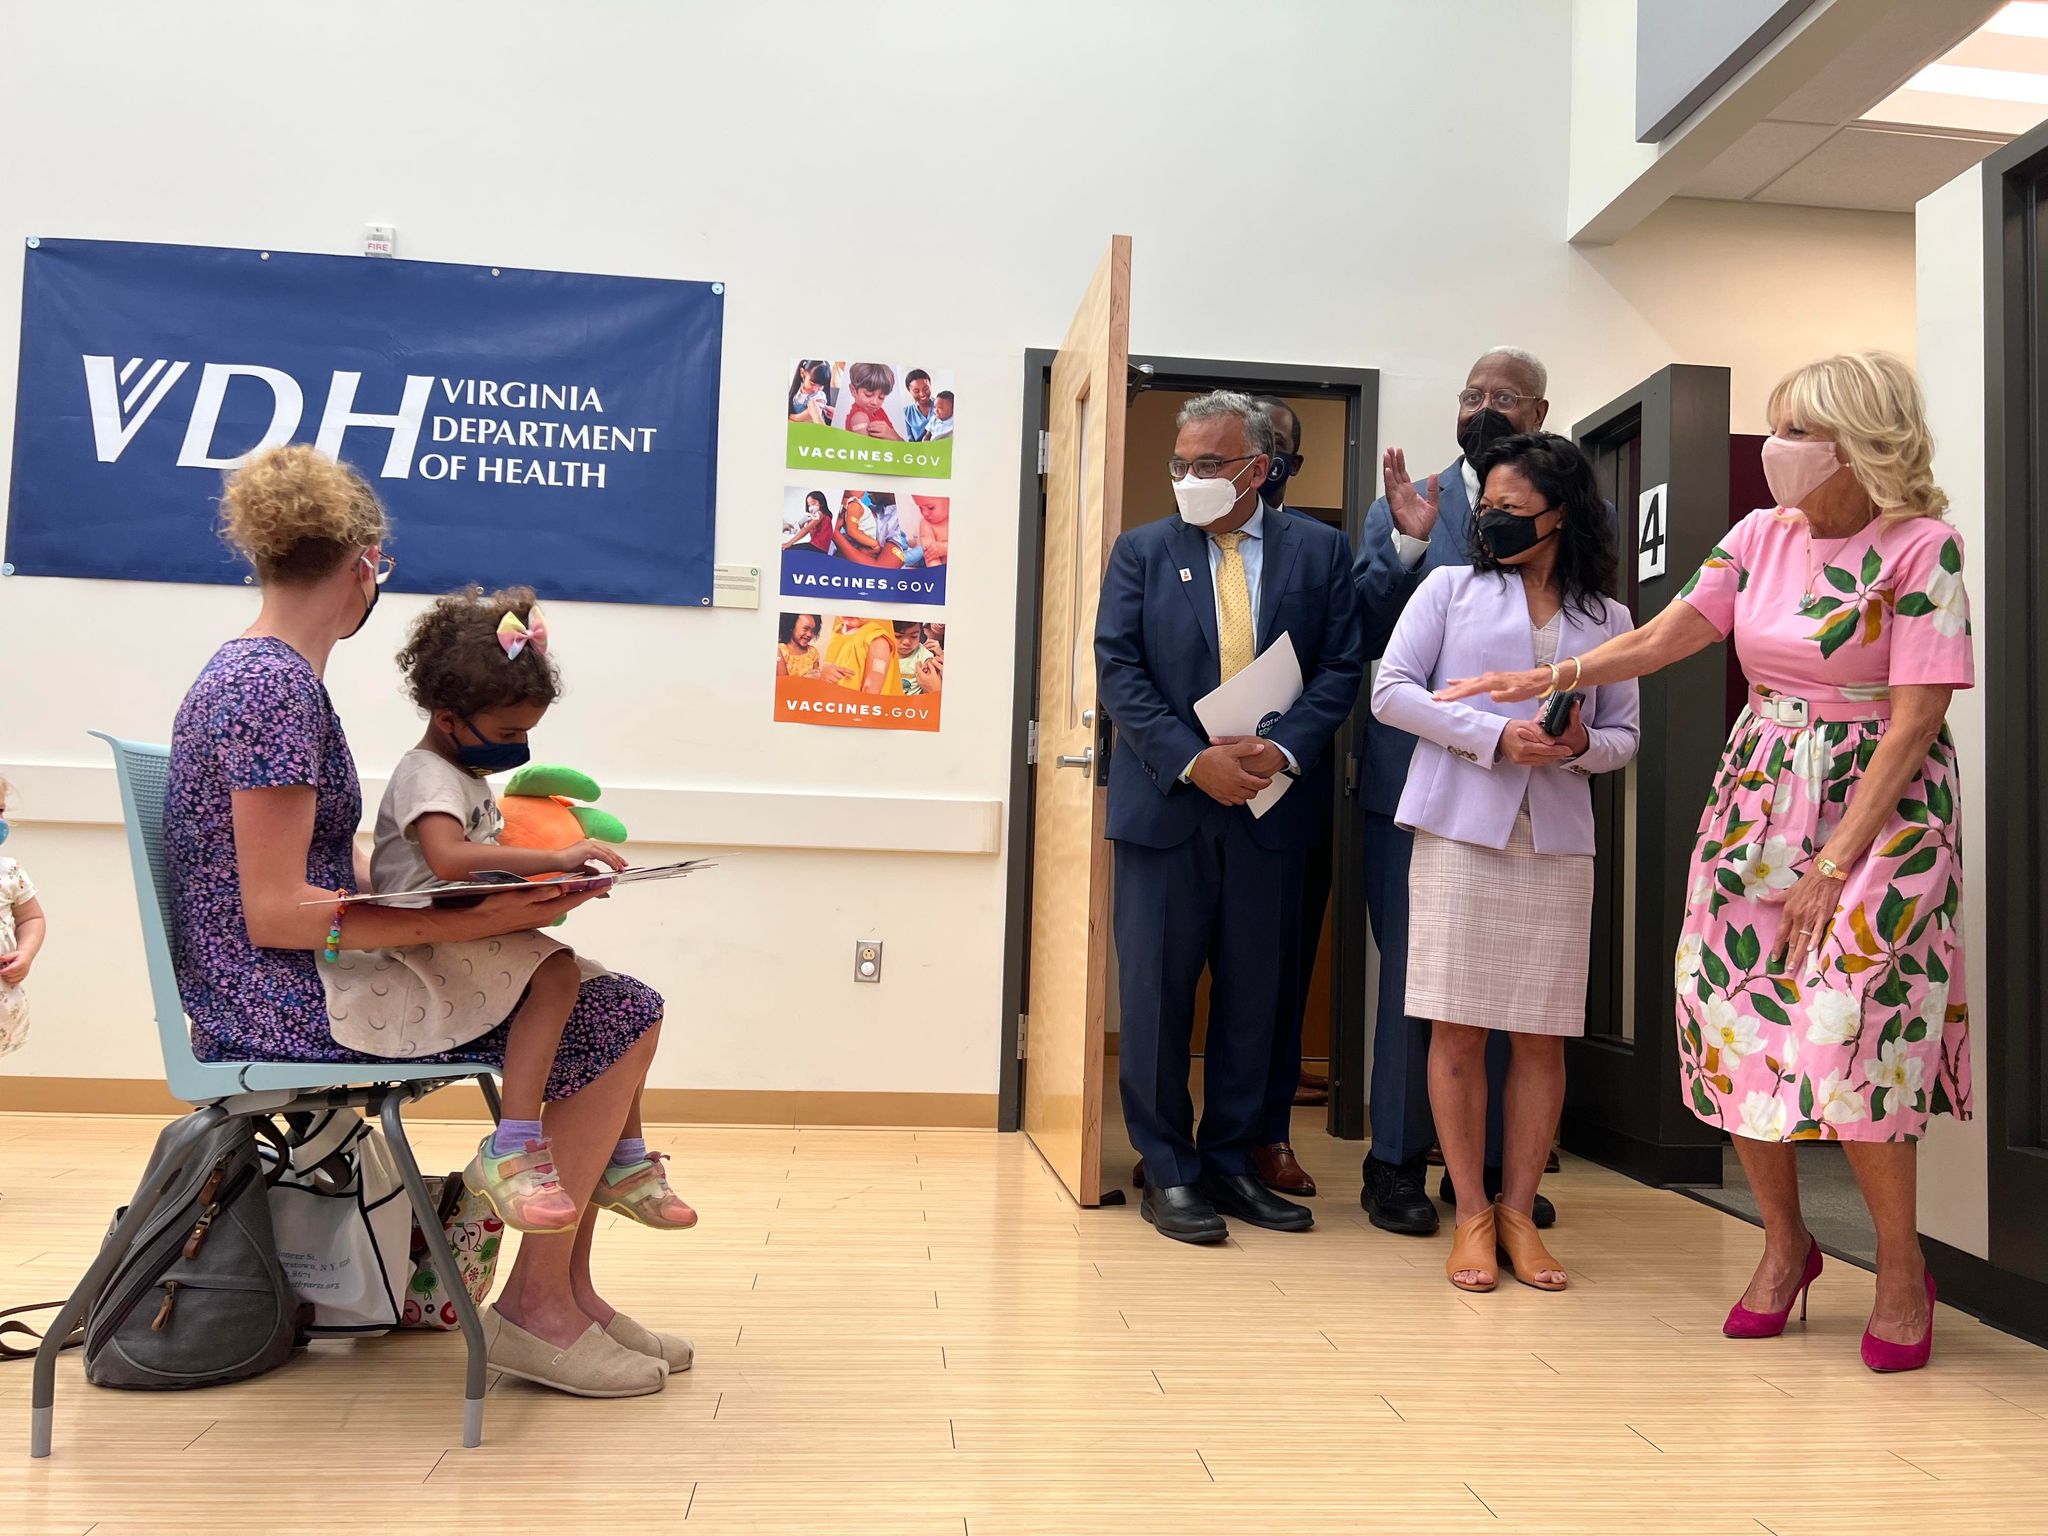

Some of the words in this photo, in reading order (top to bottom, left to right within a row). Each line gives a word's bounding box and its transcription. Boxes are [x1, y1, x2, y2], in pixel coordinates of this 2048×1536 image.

[367, 242, 389, 252] FIRE
[441, 377, 604, 413] VIRGINIA
[83, 354, 435, 479] VDH
[432, 416, 657, 453] DEPARTMENT
[798, 445, 940, 467] VACCINES.GOV
[418, 453, 467, 480] OF
[477, 457, 606, 488] HEALTH
[1639, 492, 1665, 567] 4
[792, 573, 935, 593] VACCINES.GOV
[786, 699, 929, 720] VACCINES.GOV
[1261, 719, 1273, 728] GOT
